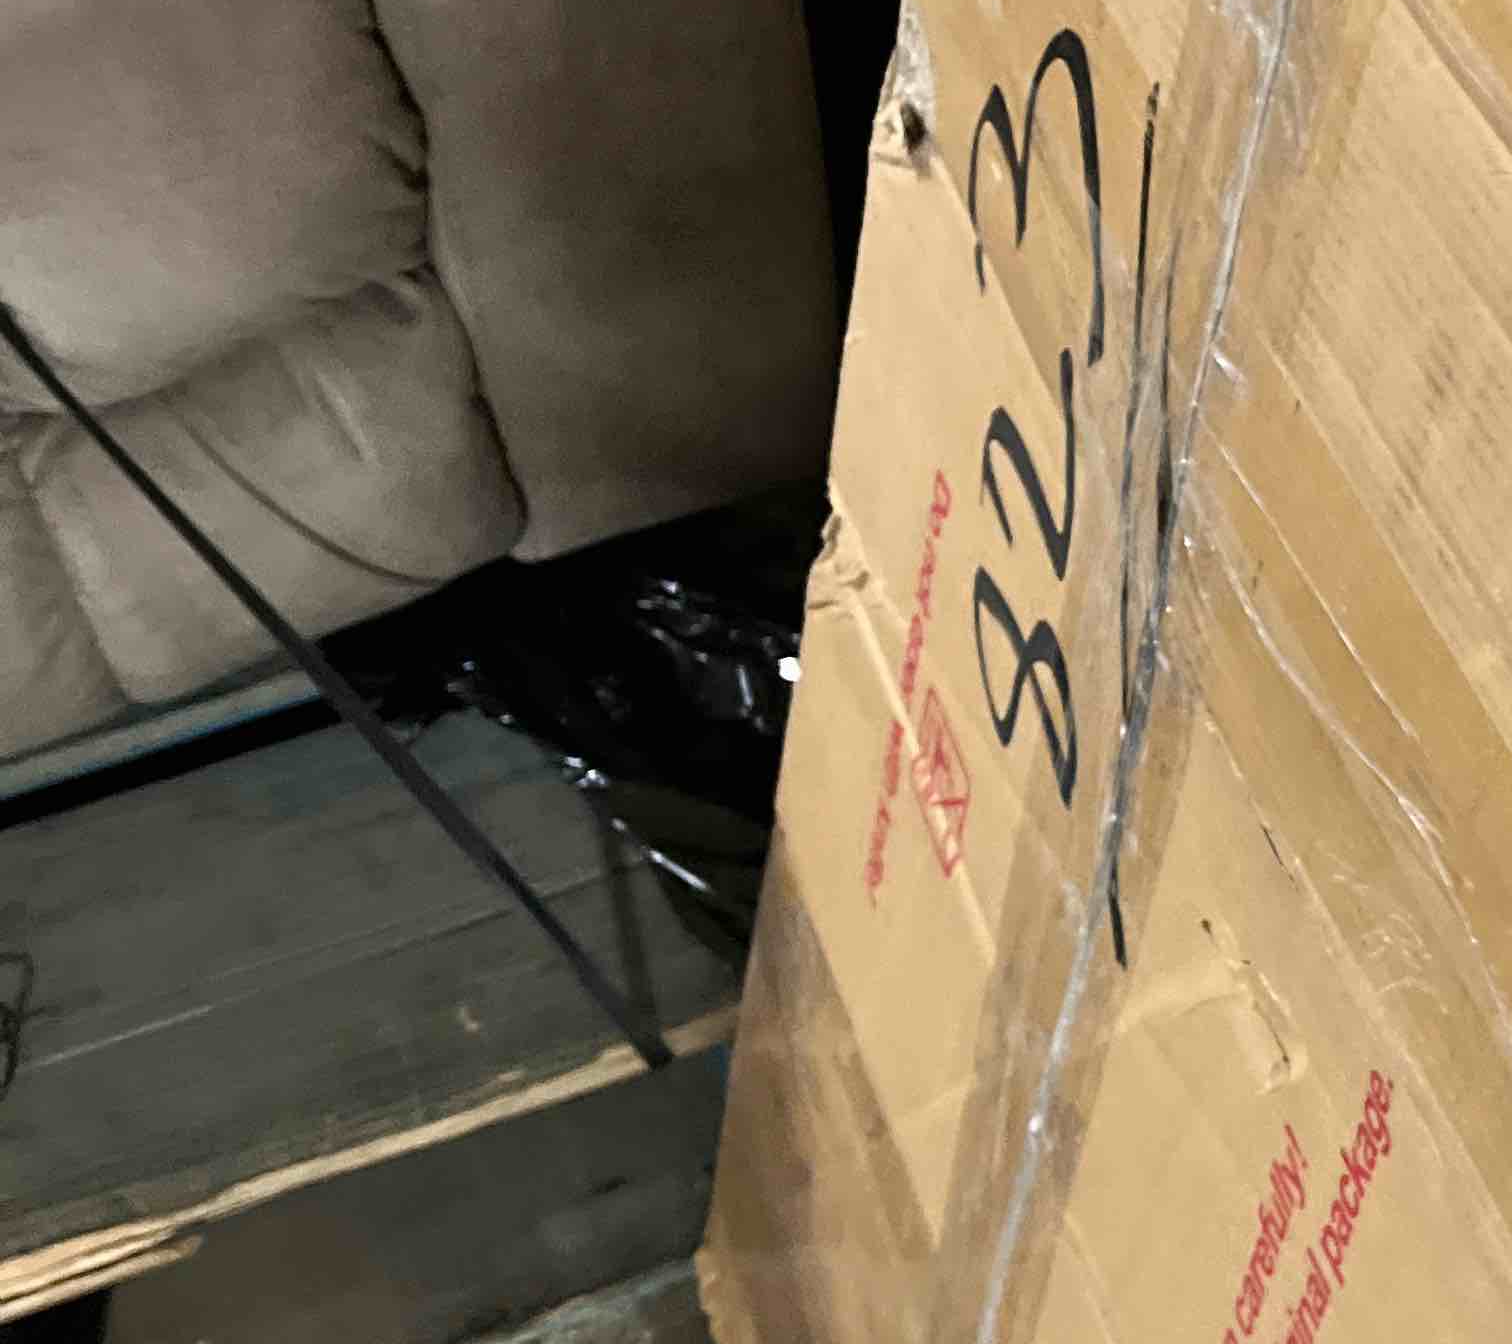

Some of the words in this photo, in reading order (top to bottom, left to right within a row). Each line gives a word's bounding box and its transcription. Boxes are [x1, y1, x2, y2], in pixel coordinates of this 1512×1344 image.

[970, 27, 1103, 809] 823
[1234, 1122, 1308, 1336] carefully!
[1321, 1069, 1394, 1288] package.
